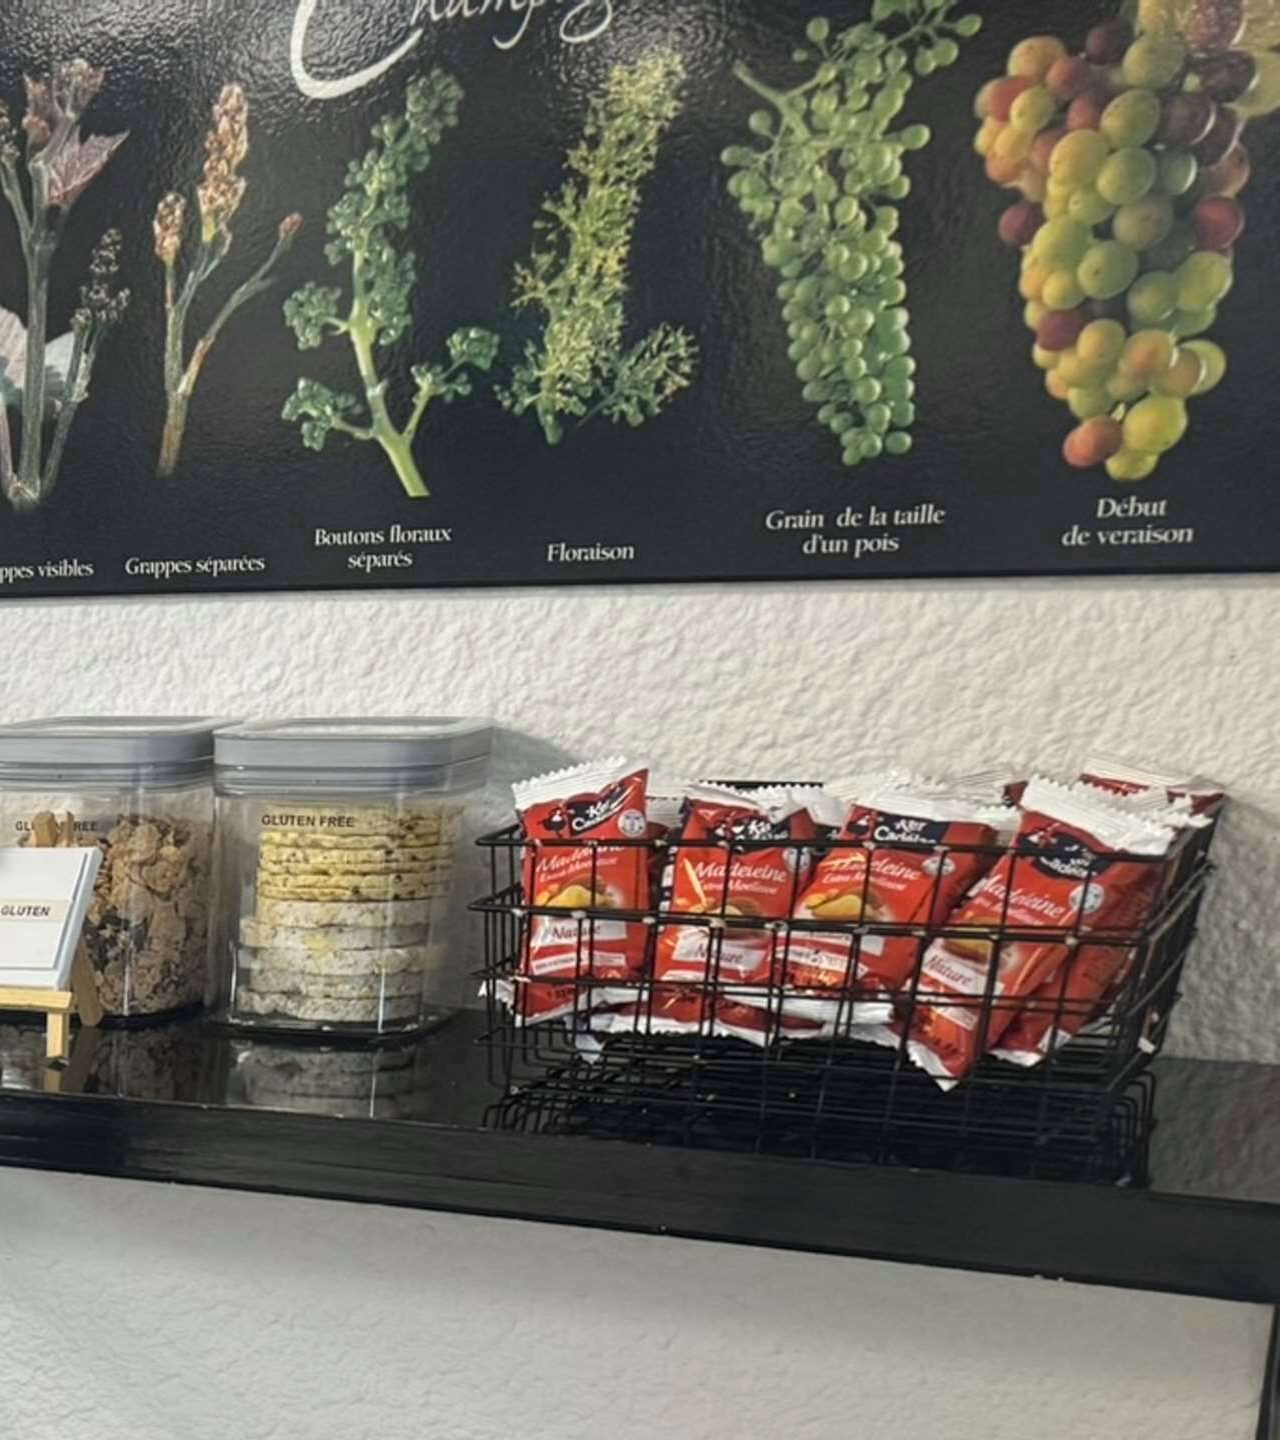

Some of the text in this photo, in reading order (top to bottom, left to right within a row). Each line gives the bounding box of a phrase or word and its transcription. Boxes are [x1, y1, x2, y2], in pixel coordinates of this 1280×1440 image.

[765, 504, 945, 530] Grain de la taille
[1096, 497, 1166, 518] Début
[314, 524, 452, 546] Boutons floraux
[803, 533, 900, 558] d'un pois
[1062, 524, 1194, 546] de veraison
[347, 550, 413, 571] séparés
[546, 542, 635, 562] Floraison
[37, 560, 94, 578] visibles
[124, 553, 265, 578] Grappes séparées
[261, 814, 355, 828] GLUTEN FREE
[0, 905, 51, 917] GLUTEN
